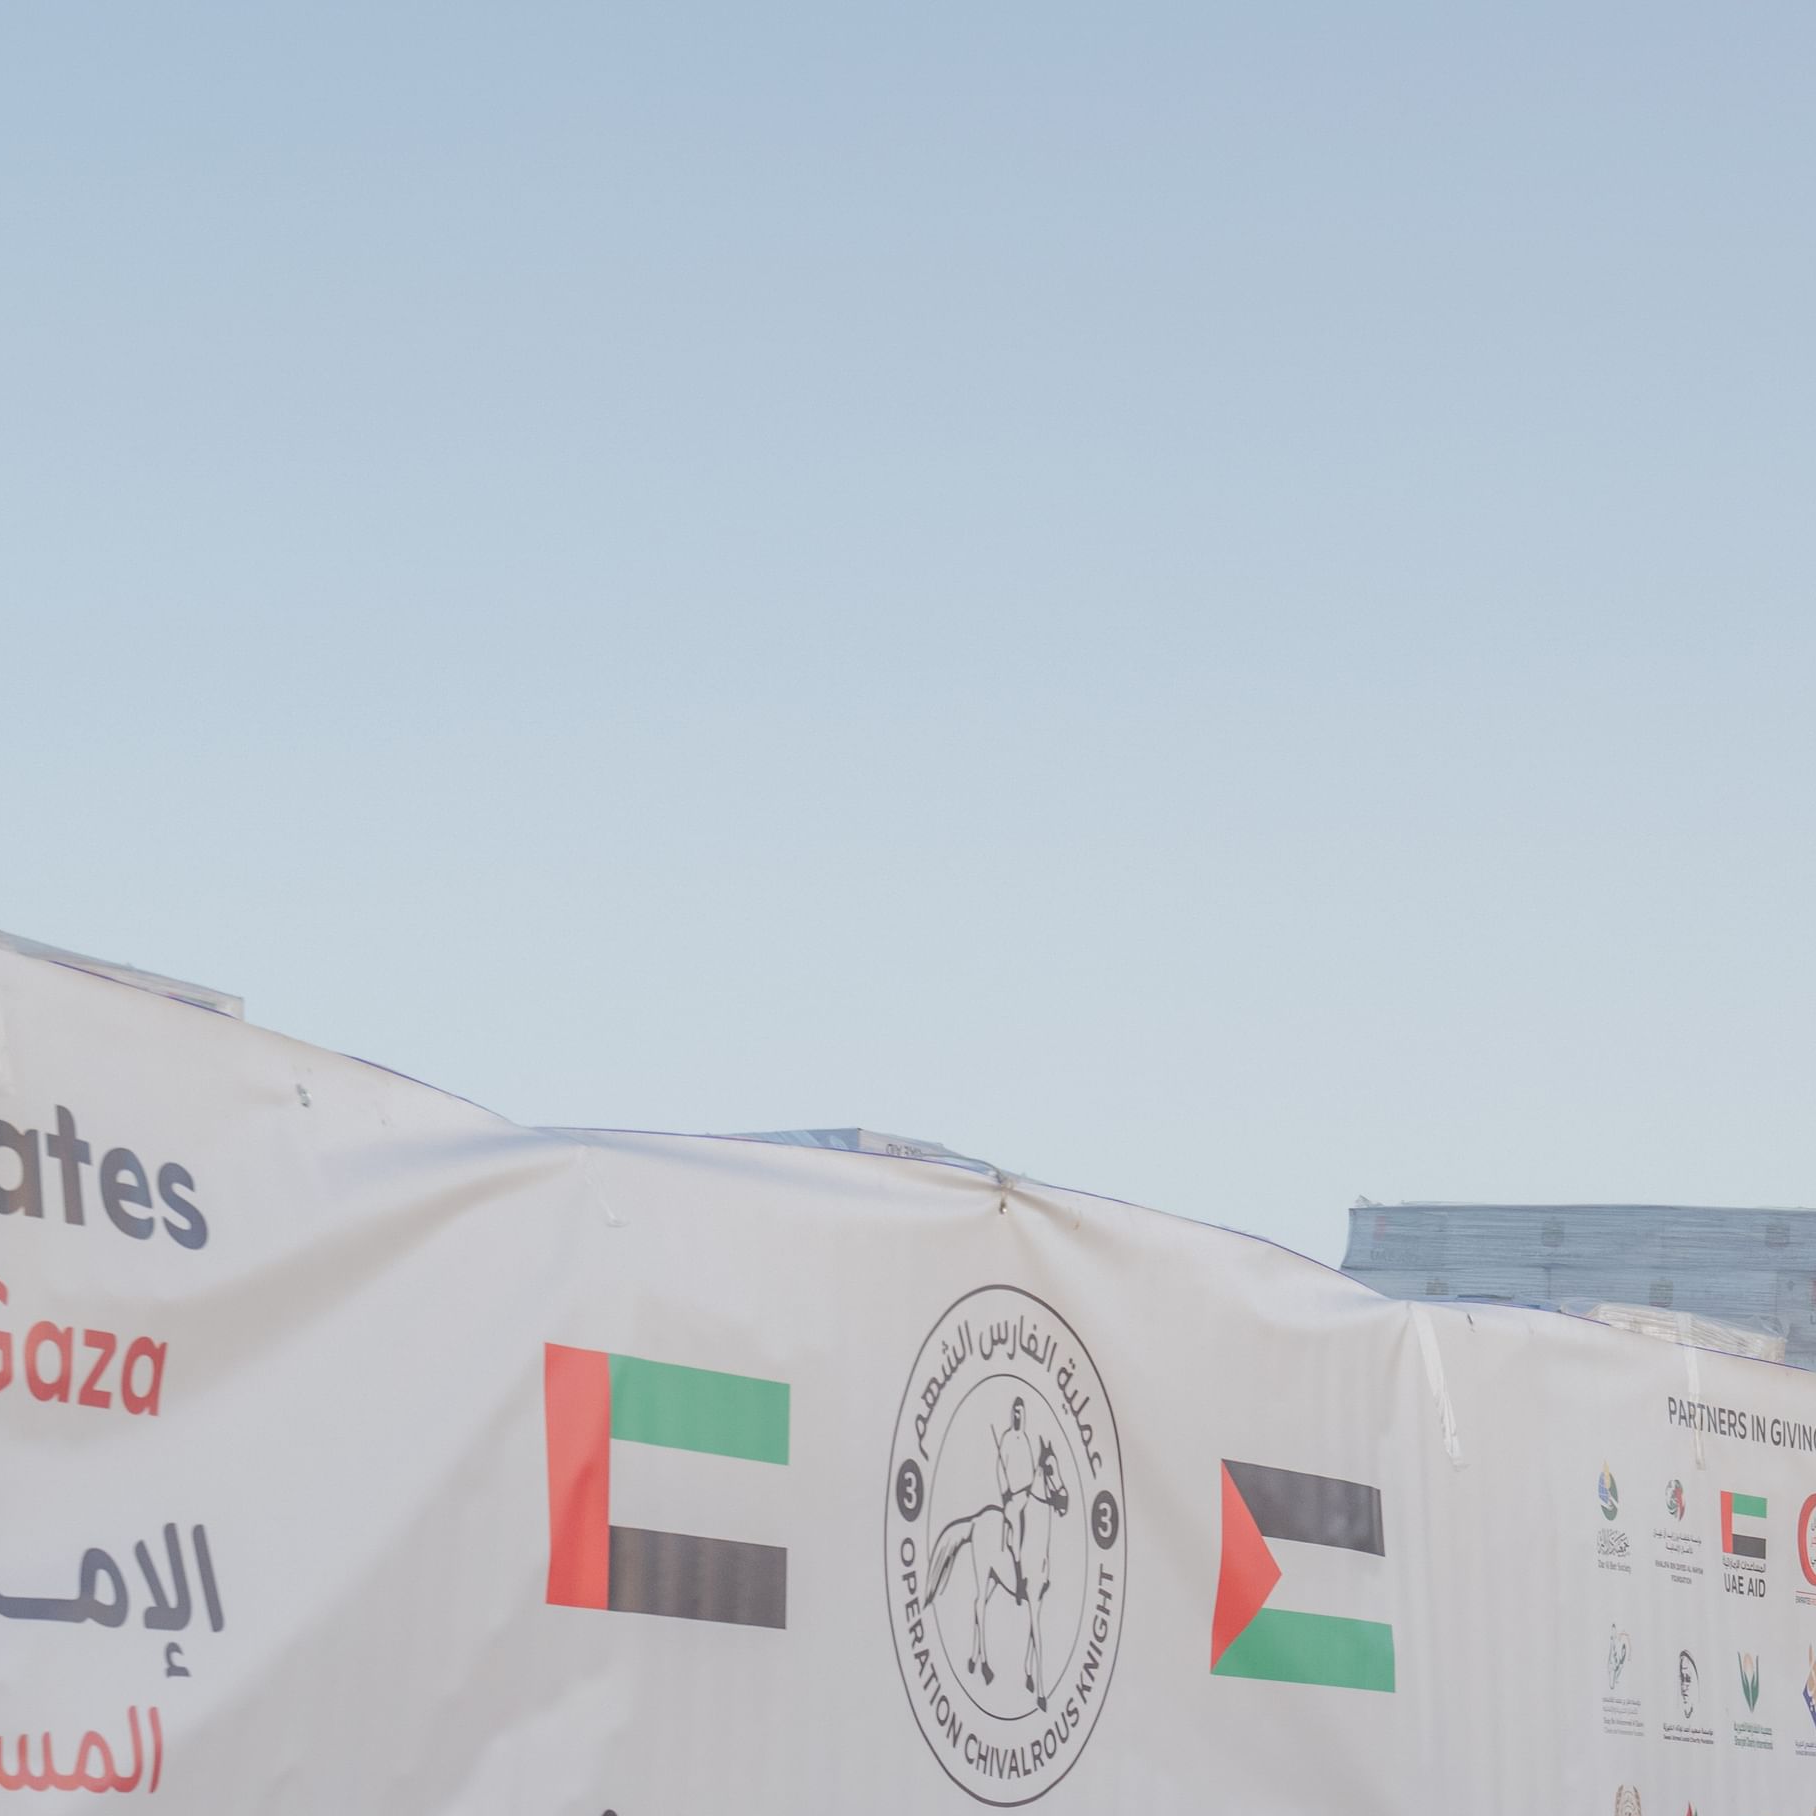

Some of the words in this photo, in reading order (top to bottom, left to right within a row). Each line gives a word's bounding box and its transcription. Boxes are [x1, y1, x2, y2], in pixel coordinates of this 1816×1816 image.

[979, 1314, 1058, 1373] الفارس
[914, 1319, 974, 1463] الشهم
[1056, 1357, 1103, 1480] عملية
[1667, 1396, 1747, 1440] PARTNERS
[1751, 1414, 1767, 1444] IN
[1724, 1573, 1745, 1595] UAE
[1747, 1577, 1767, 1598] AID
[900, 1537, 963, 1748] OPERATION
[964, 1698, 1080, 1780] CHIVALROUS
[1075, 1563, 1114, 1705] KNIGHT
